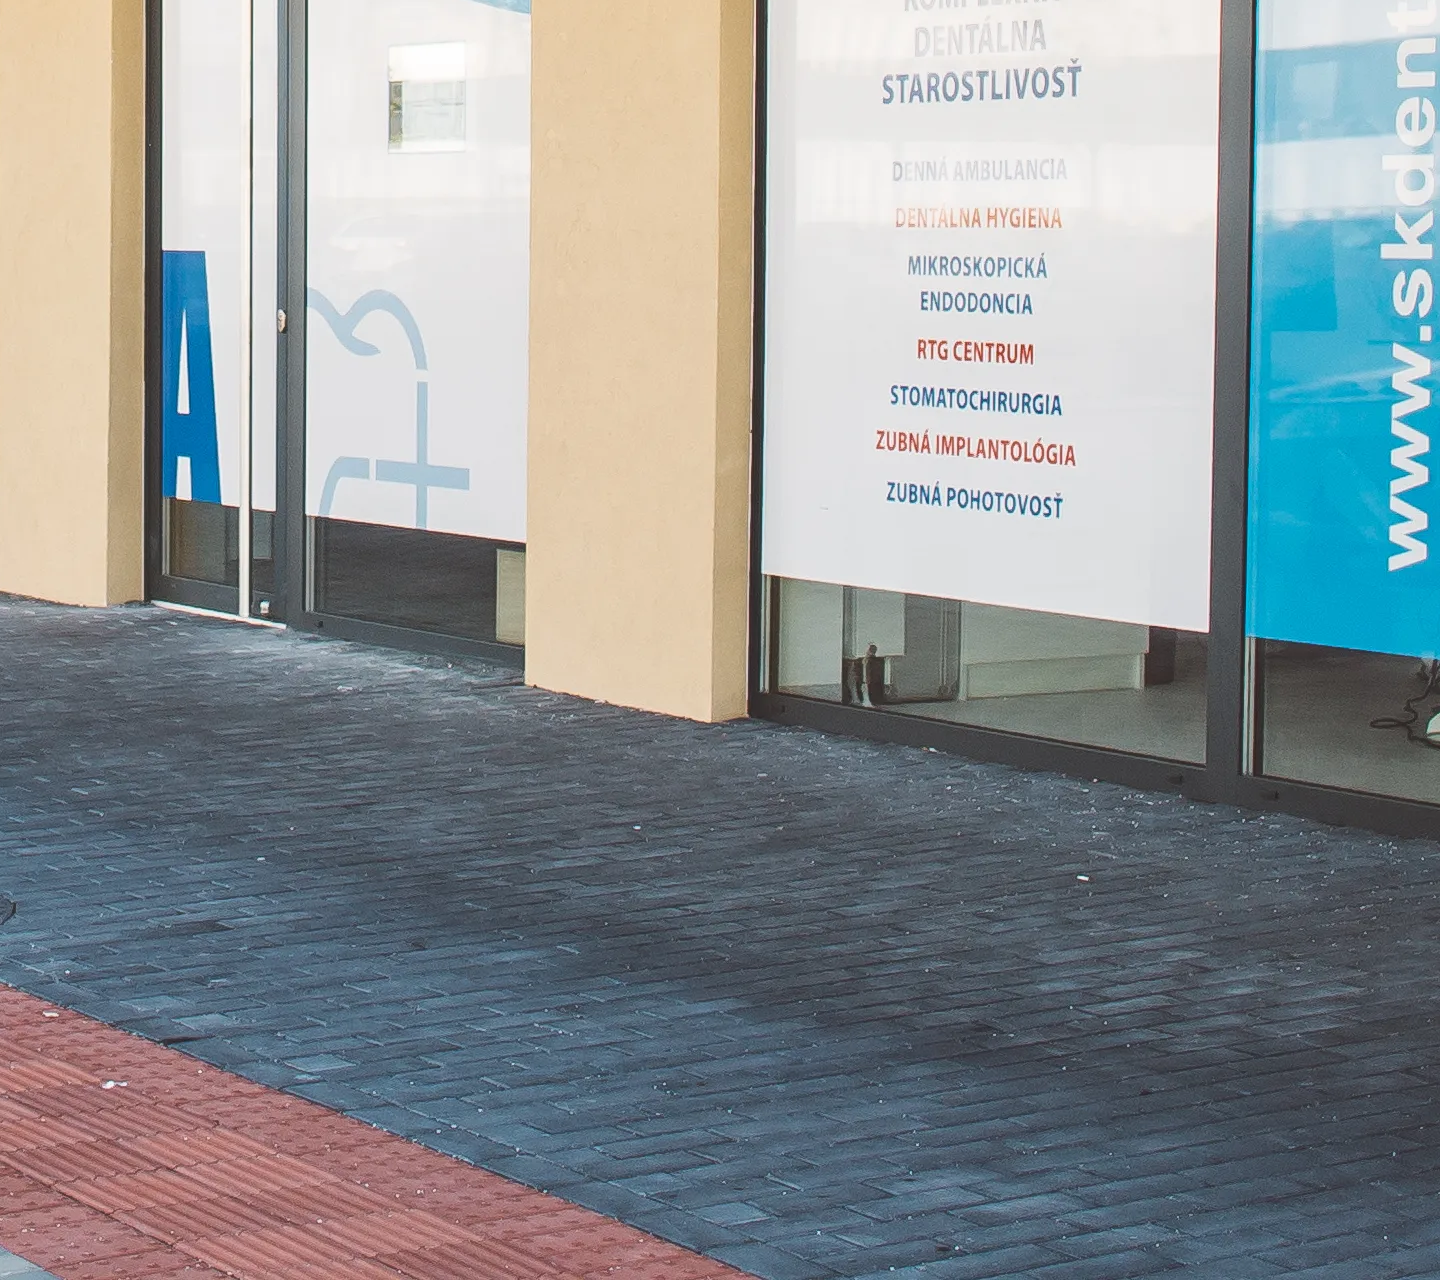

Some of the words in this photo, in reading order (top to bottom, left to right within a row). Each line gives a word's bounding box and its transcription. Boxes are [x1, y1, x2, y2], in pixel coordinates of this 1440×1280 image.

[914, 15, 1047, 58] DENTÁLNA
[882, 57, 1082, 105] STAROSTLIVOSŤ
[892, 156, 948, 182] DENNÁ
[953, 157, 1068, 182] AMBULANCIA
[895, 203, 982, 229] DENTÁLNA
[987, 207, 1063, 229] HYGIENA
[908, 252, 1048, 279] MIKROSKOPICKÁ
[920, 290, 1033, 315] ENDODONCIA
[917, 339, 948, 361] RTG
[953, 341, 1035, 366] CENTRUM
[890, 385, 1063, 416] STOMATOCHIRURGIA
[875, 428, 931, 454] ZUBNÁ
[936, 434, 1076, 466] IMPLANTOLÓGIA
[886, 481, 942, 506] ZUBNÁ
[946, 487, 1064, 519] POHOTOVOSŤ
